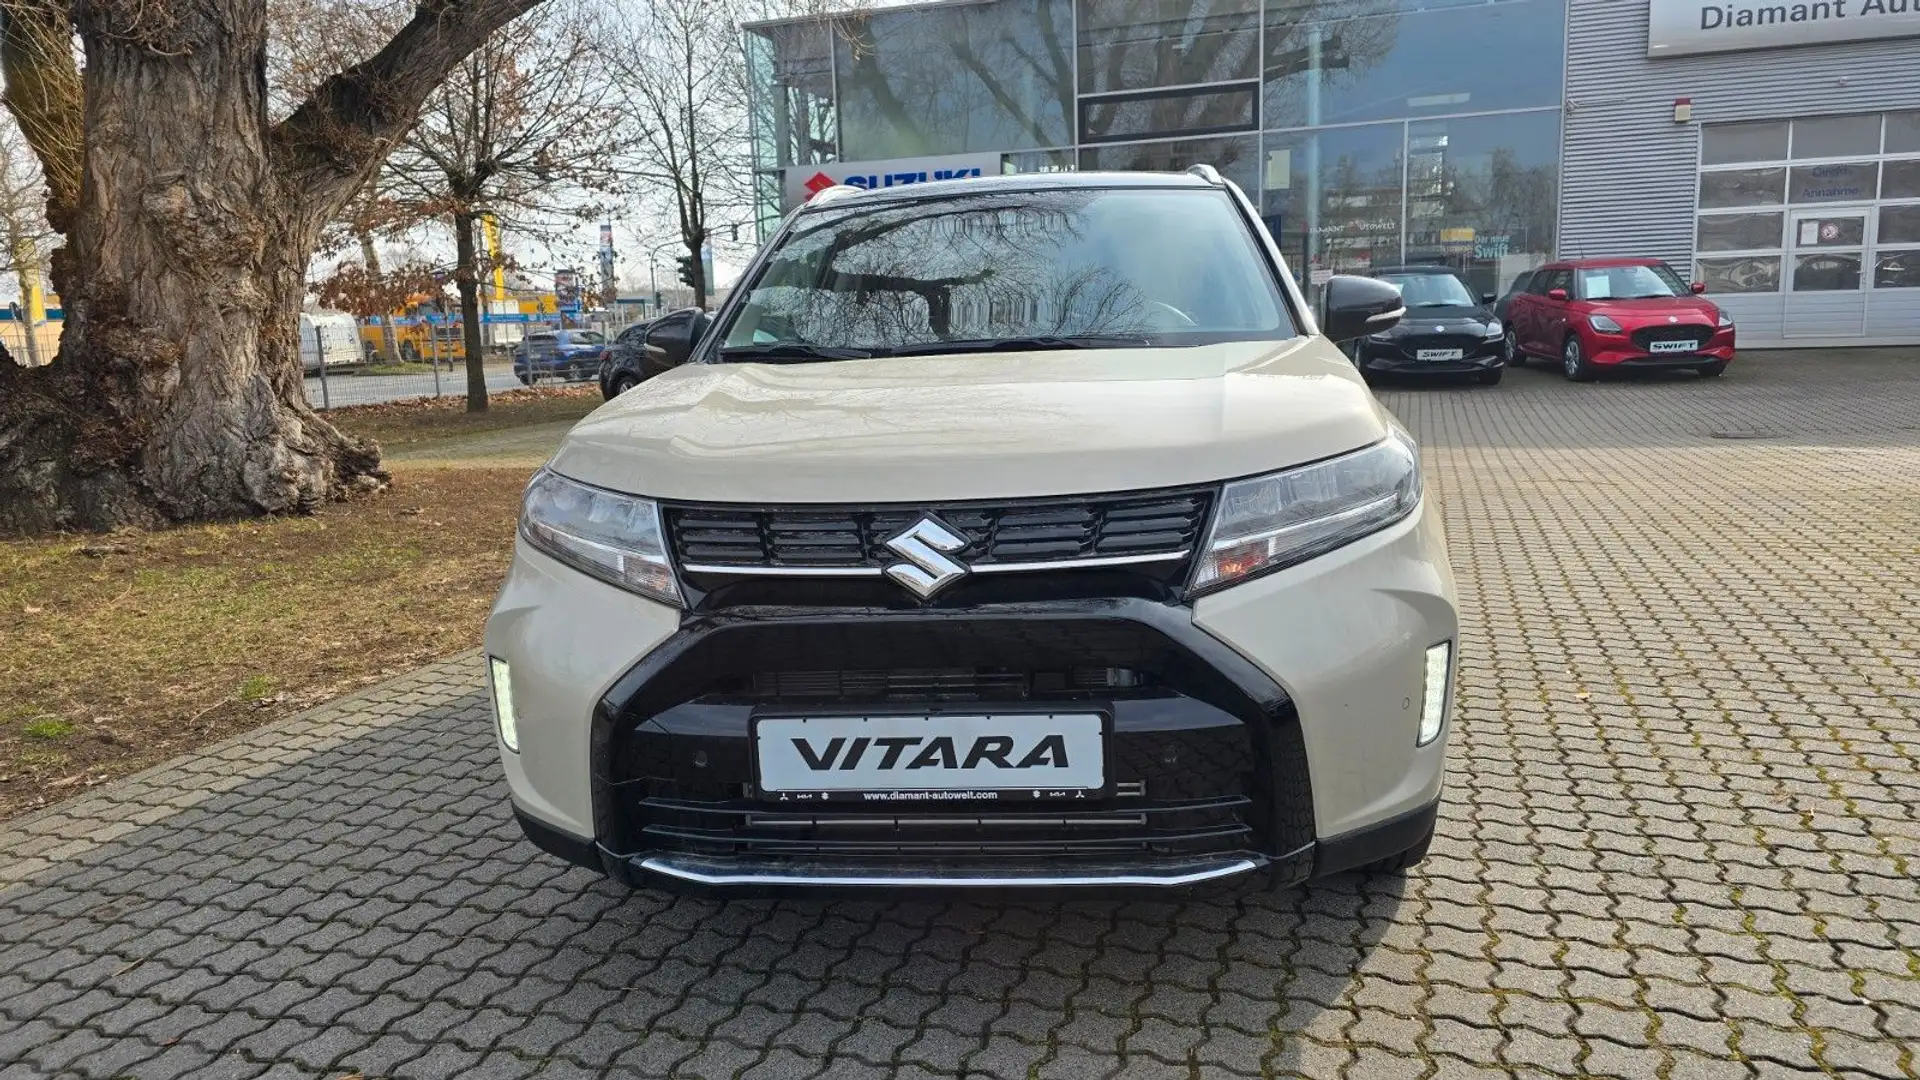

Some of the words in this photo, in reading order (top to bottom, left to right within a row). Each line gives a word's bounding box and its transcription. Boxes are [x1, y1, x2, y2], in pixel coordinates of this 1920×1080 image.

[1701, 0, 1846, 30] Diamant
[1474, 243, 1510, 259] Swift
[1653, 342, 1696, 350] SWIFT
[1422, 350, 1458, 358] SWIFT
[790, 735, 1070, 771] VITARA
[863, 790, 998, 801] www.diamant-autowelt.com
